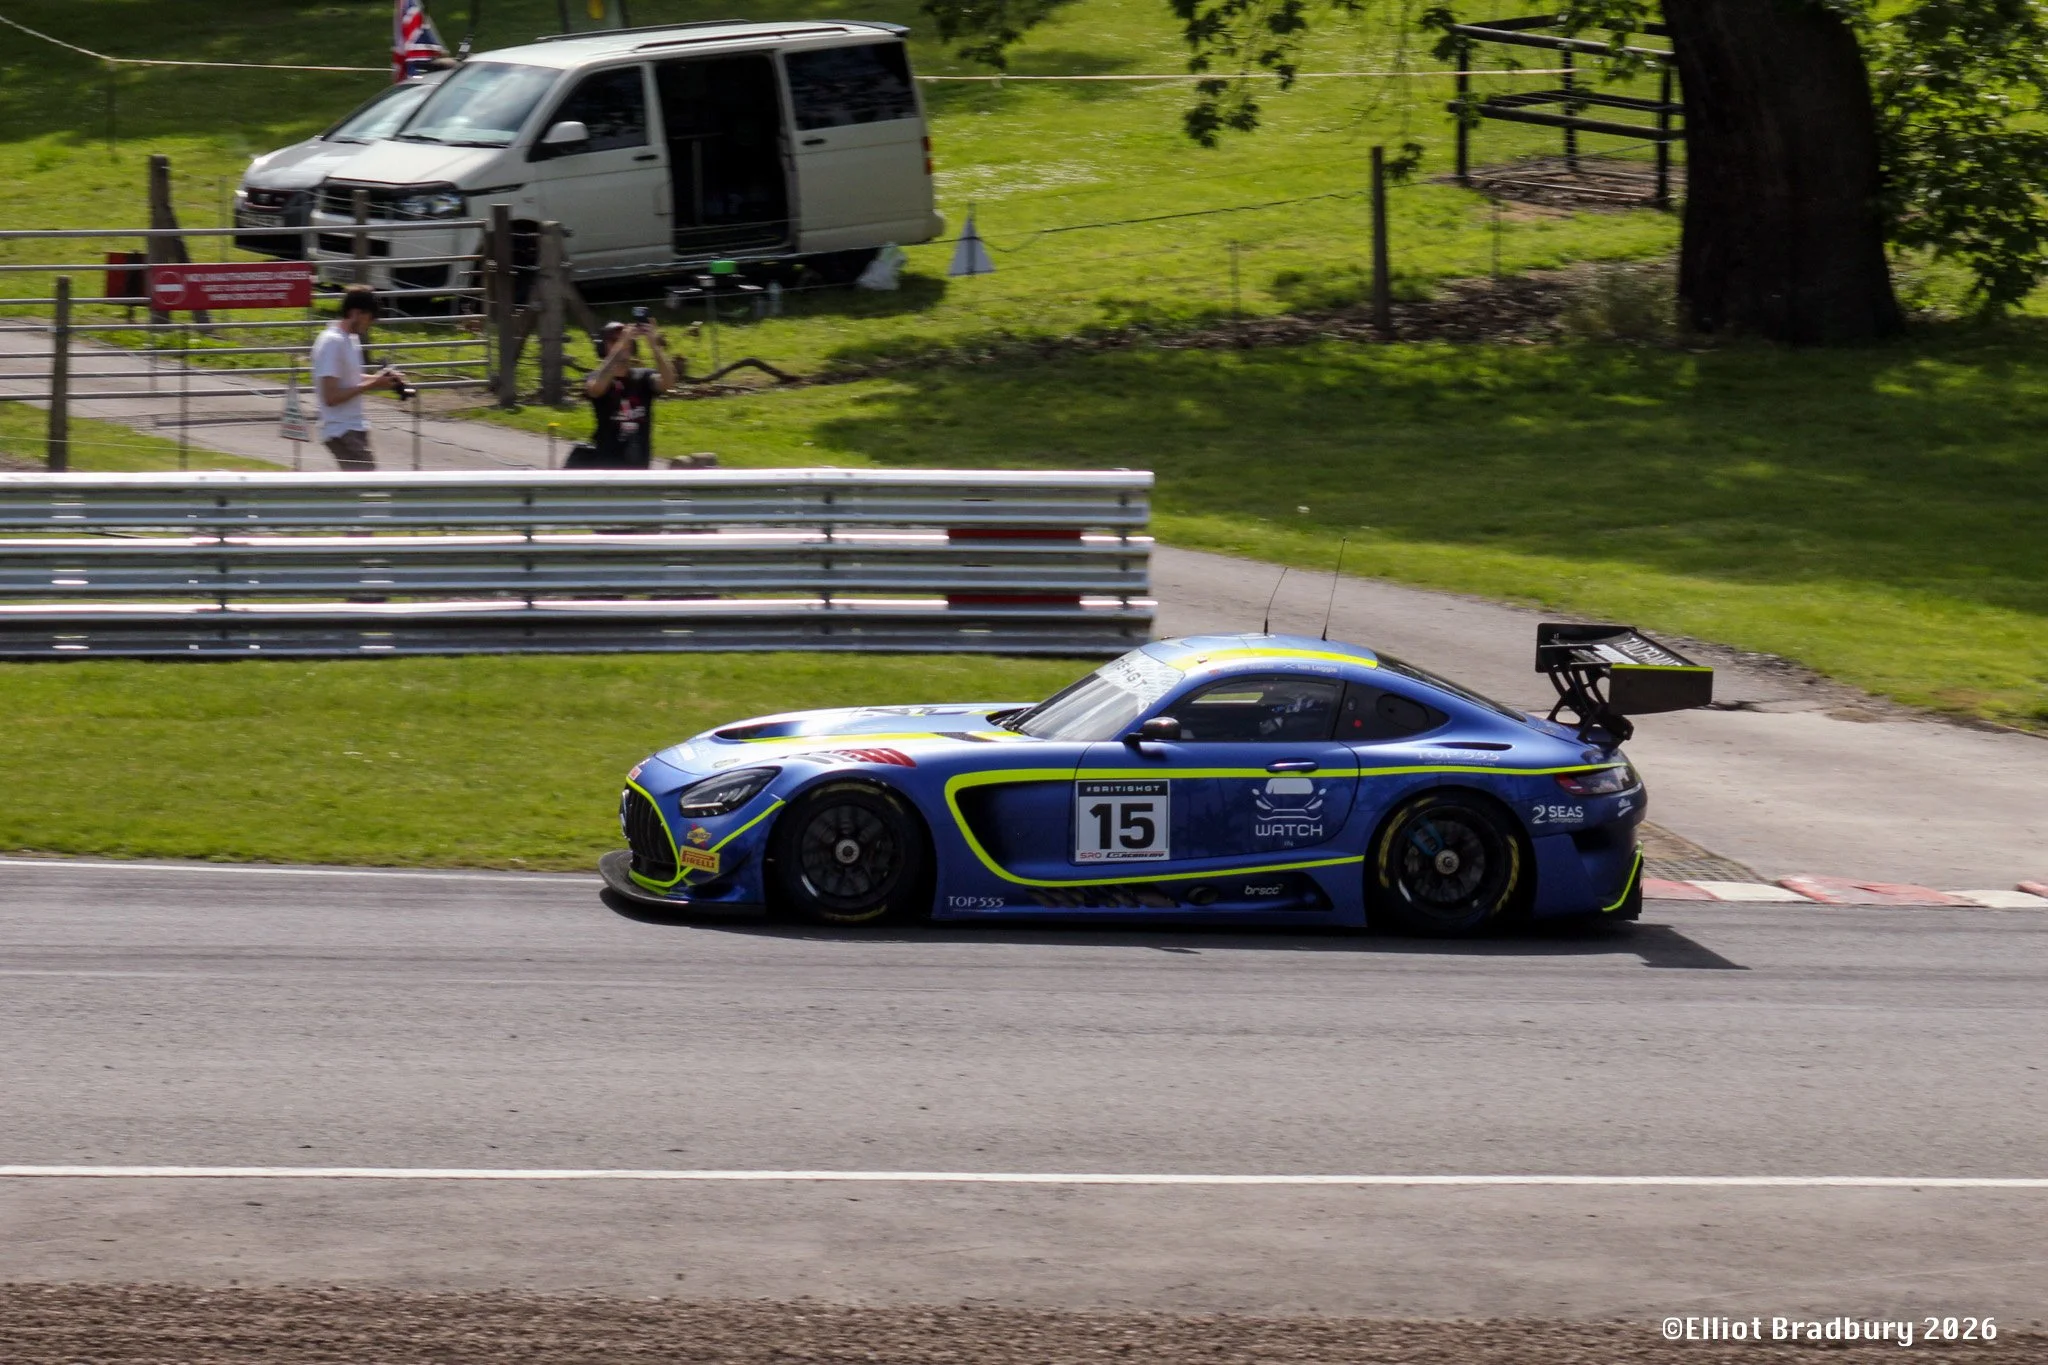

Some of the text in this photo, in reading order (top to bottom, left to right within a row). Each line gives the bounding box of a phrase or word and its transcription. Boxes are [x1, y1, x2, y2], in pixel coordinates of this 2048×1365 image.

[1548, 805, 1585, 818] SEAS
[1089, 802, 1155, 850] 15
[1255, 823, 1323, 837] WATCH
[682, 849, 716, 869] PIRELLI
[947, 895, 1005, 908] TOP 555
